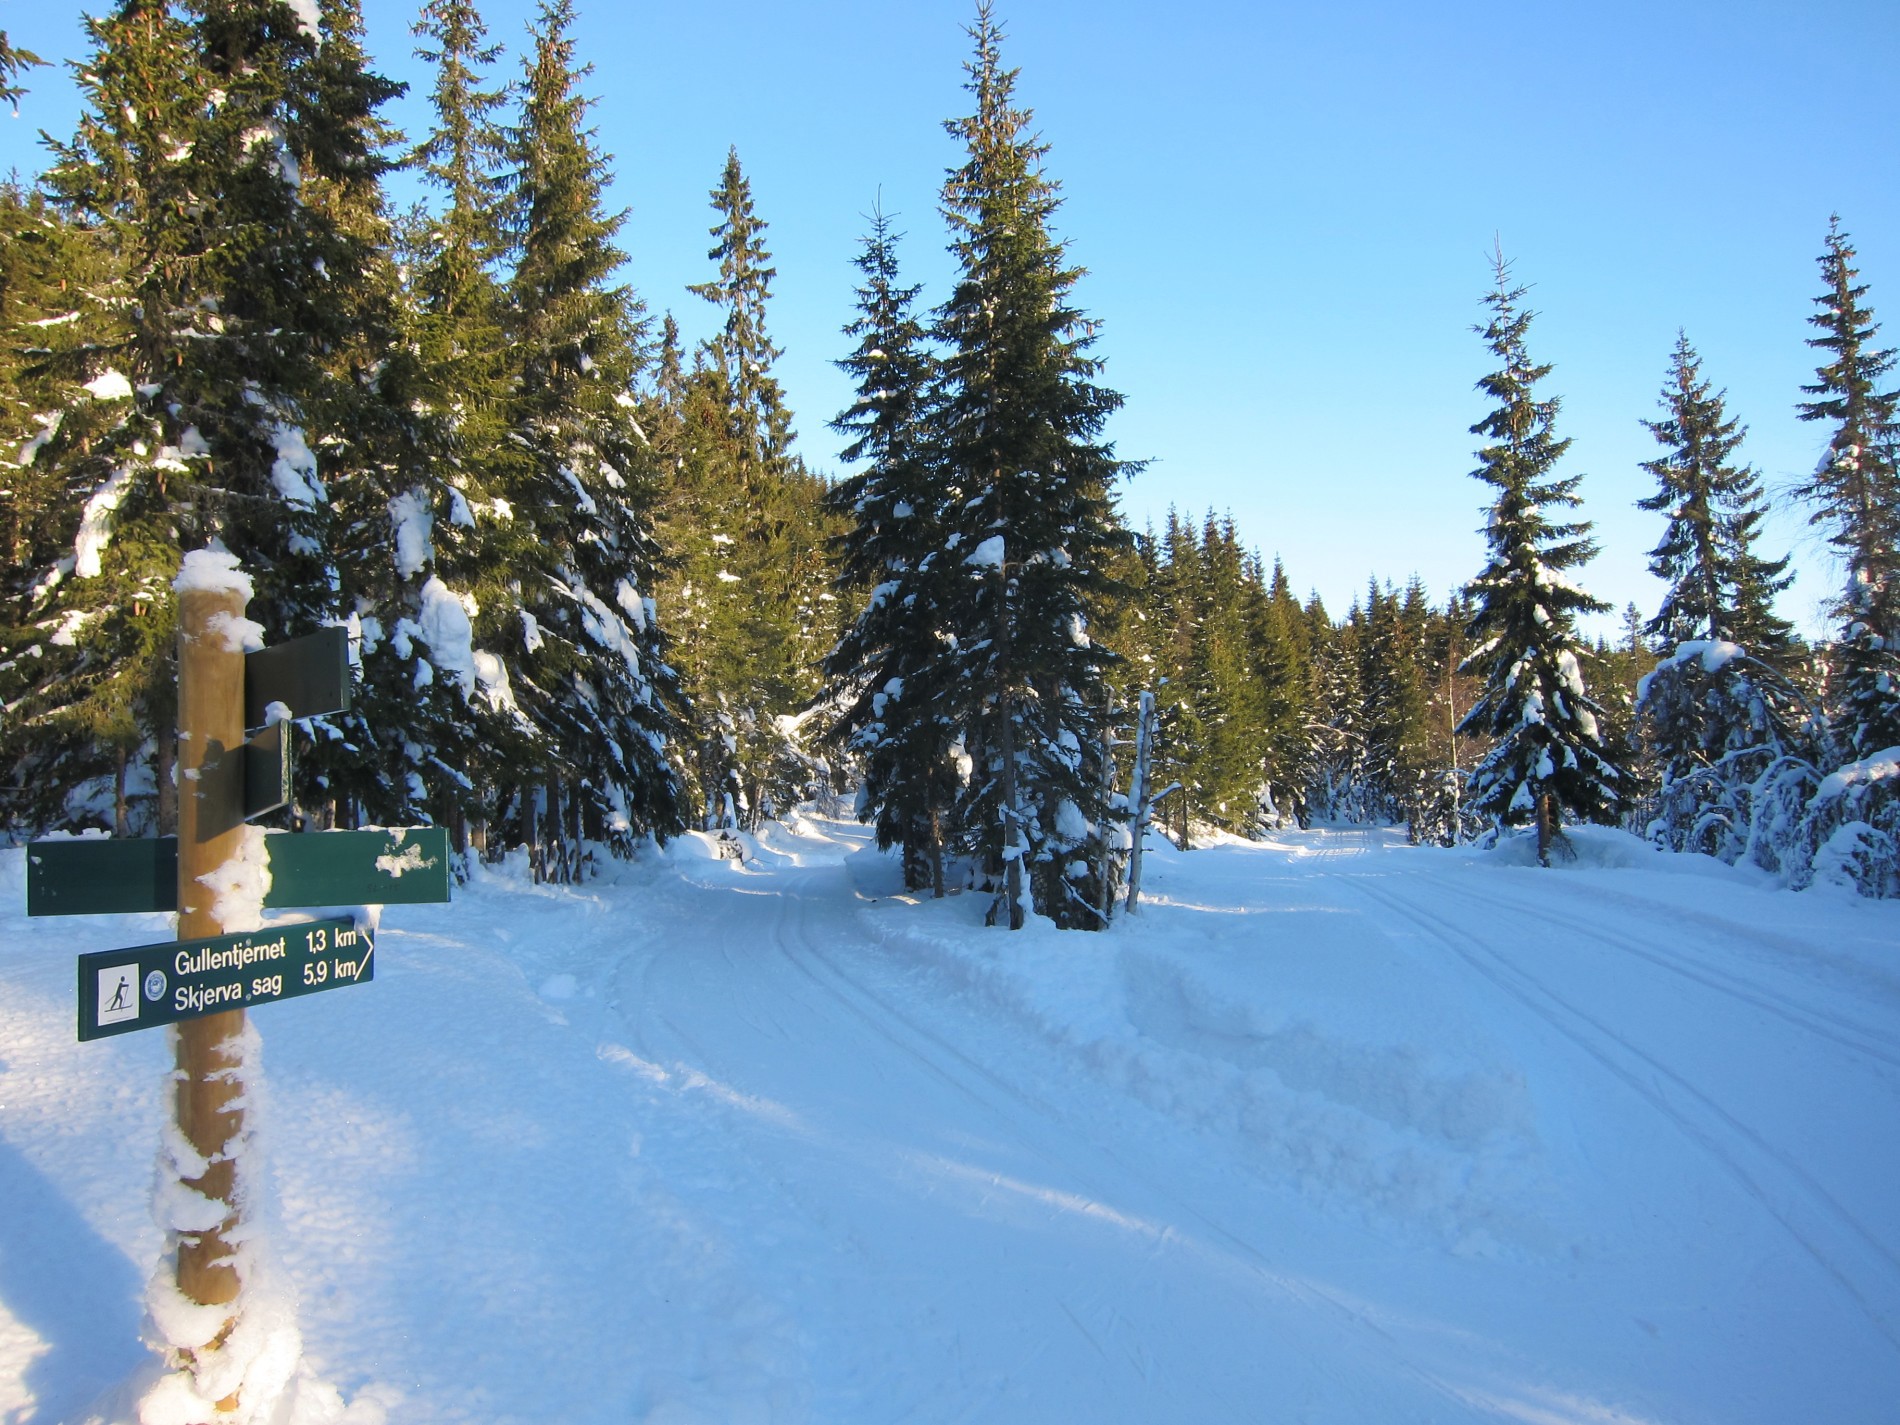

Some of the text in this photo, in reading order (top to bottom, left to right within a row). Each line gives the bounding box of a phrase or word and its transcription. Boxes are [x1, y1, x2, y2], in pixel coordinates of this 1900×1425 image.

[175, 928, 357, 976] Gullentjernet 1,3 km
[174, 982, 242, 1012] Skjerva
[252, 974, 282, 996] sag
[303, 961, 328, 986] 5,9
[334, 958, 357, 979] km
